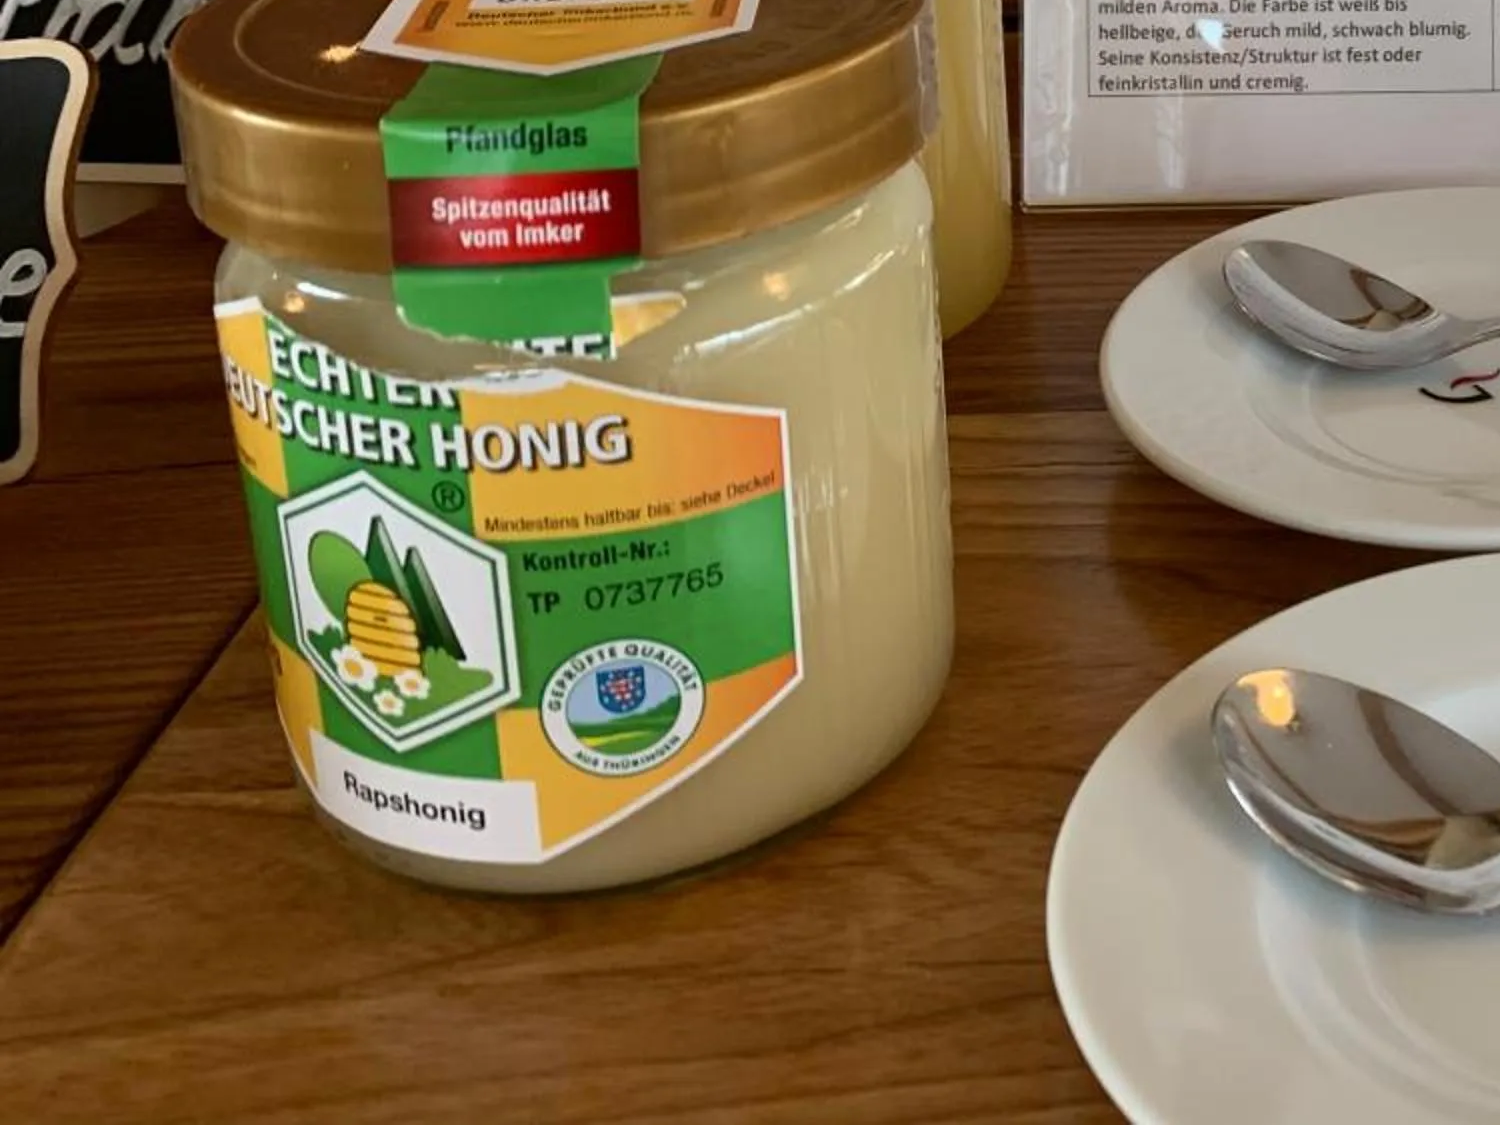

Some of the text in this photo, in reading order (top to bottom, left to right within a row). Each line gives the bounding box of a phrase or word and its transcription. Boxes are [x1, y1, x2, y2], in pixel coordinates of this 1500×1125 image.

[1160, 0, 1225, 15] Aroma.
[1097, 23, 1181, 44] hellbeige,
[1284, 21, 1328, 40] mild,
[1331, 20, 1405, 39] schwach
[1408, 20, 1471, 41] blumig.
[1097, 46, 1423, 68] Seine Konsistenz/Struktur ist fest oder
[1097, 73, 1309, 93] feinkristallin und cremig.
[446, 122, 588, 154] Pfandglas
[432, 188, 611, 223] Spitzenqualität
[460, 222, 584, 249] vom Imker
[430, 415, 632, 472] HONIG
[485, 515, 579, 533] Mindestens
[584, 508, 642, 525] haltbar
[680, 491, 722, 512] siehe
[726, 471, 776, 499] Deckel
[523, 539, 671, 573] Kontroll-Nr.:
[528, 562, 724, 613] TP 0737765
[548, 643, 697, 711] GEPRÜFTE QUALITÄT
[343, 770, 487, 830] Rapshonig
